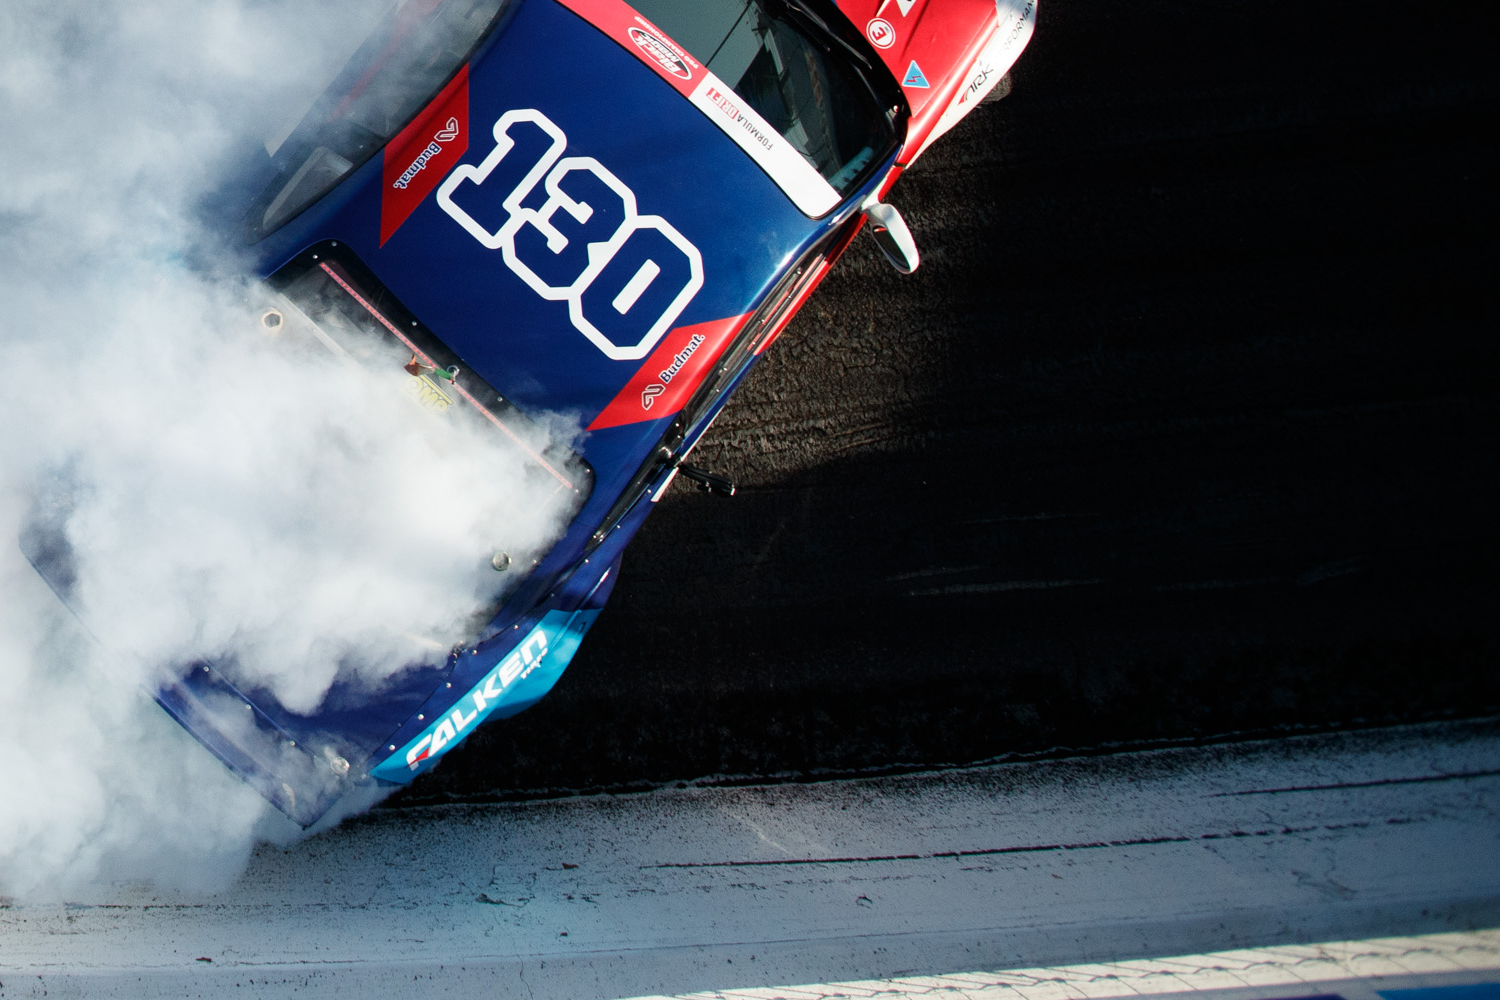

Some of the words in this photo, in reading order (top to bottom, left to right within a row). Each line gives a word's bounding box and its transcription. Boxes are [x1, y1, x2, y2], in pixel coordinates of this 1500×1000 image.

[634, 15, 685, 57] CHAMPIONSHIP
[634, 35, 682, 73] Black
[684, 55, 699, 70] PRO
[706, 87, 740, 120] DRIFT
[737, 113, 774, 151] FORMULA
[393, 141, 442, 189] Budmat.
[436, 108, 705, 361] 130
[658, 333, 706, 385] Budmat.
[404, 630, 548, 771] FALKEN
